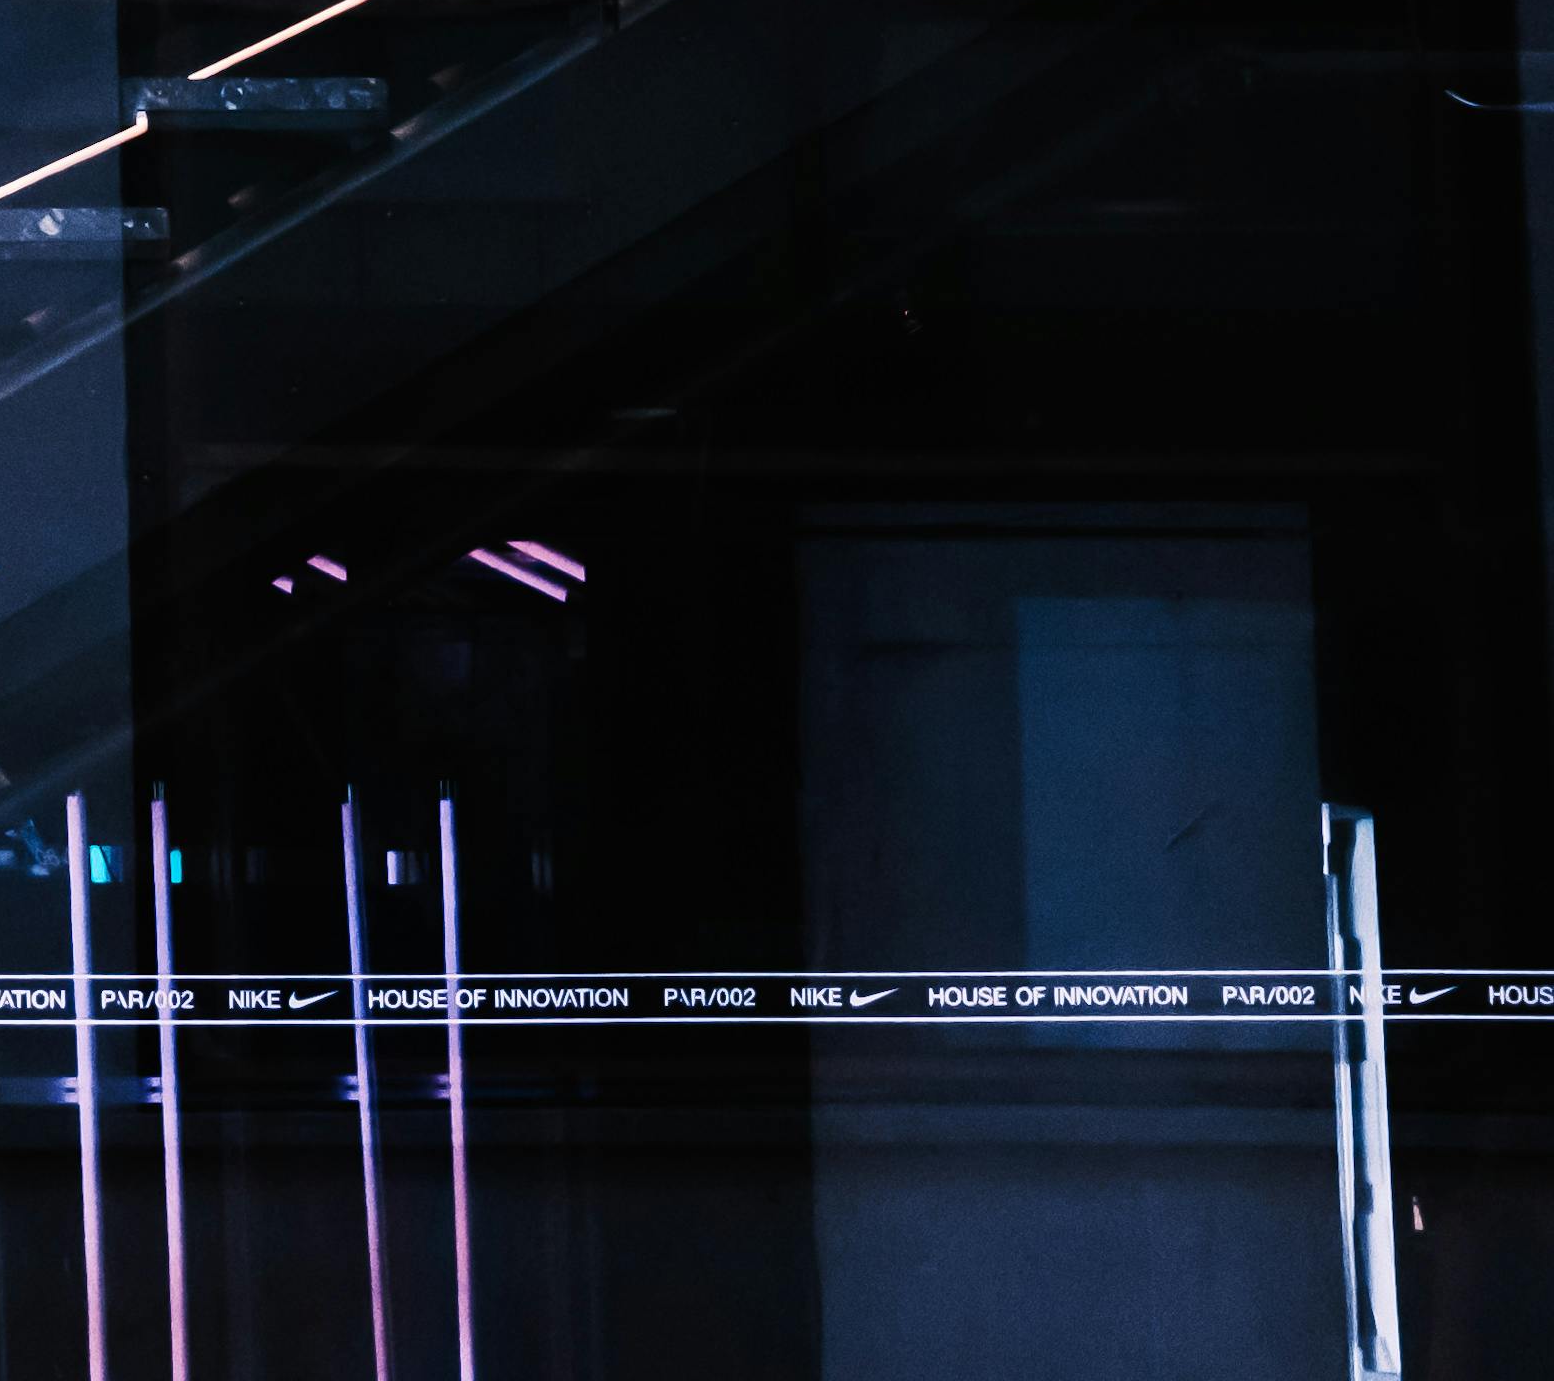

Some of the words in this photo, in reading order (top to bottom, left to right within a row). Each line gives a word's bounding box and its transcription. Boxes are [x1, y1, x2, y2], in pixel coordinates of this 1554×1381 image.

[229, 989, 281, 1009] NIKE
[368, 988, 448, 1009] HOUSE
[455, 988, 486, 1009] OF
[495, 988, 628, 1008] INNOVATION
[665, 987, 755, 1007] PAR/002
[791, 987, 843, 1007] NIKE
[929, 986, 1007, 1007] HOUSE
[1015, 985, 1046, 1007] OF
[1054, 985, 1187, 1006] INNOVATION
[1223, 985, 1314, 1005] PAR/002
